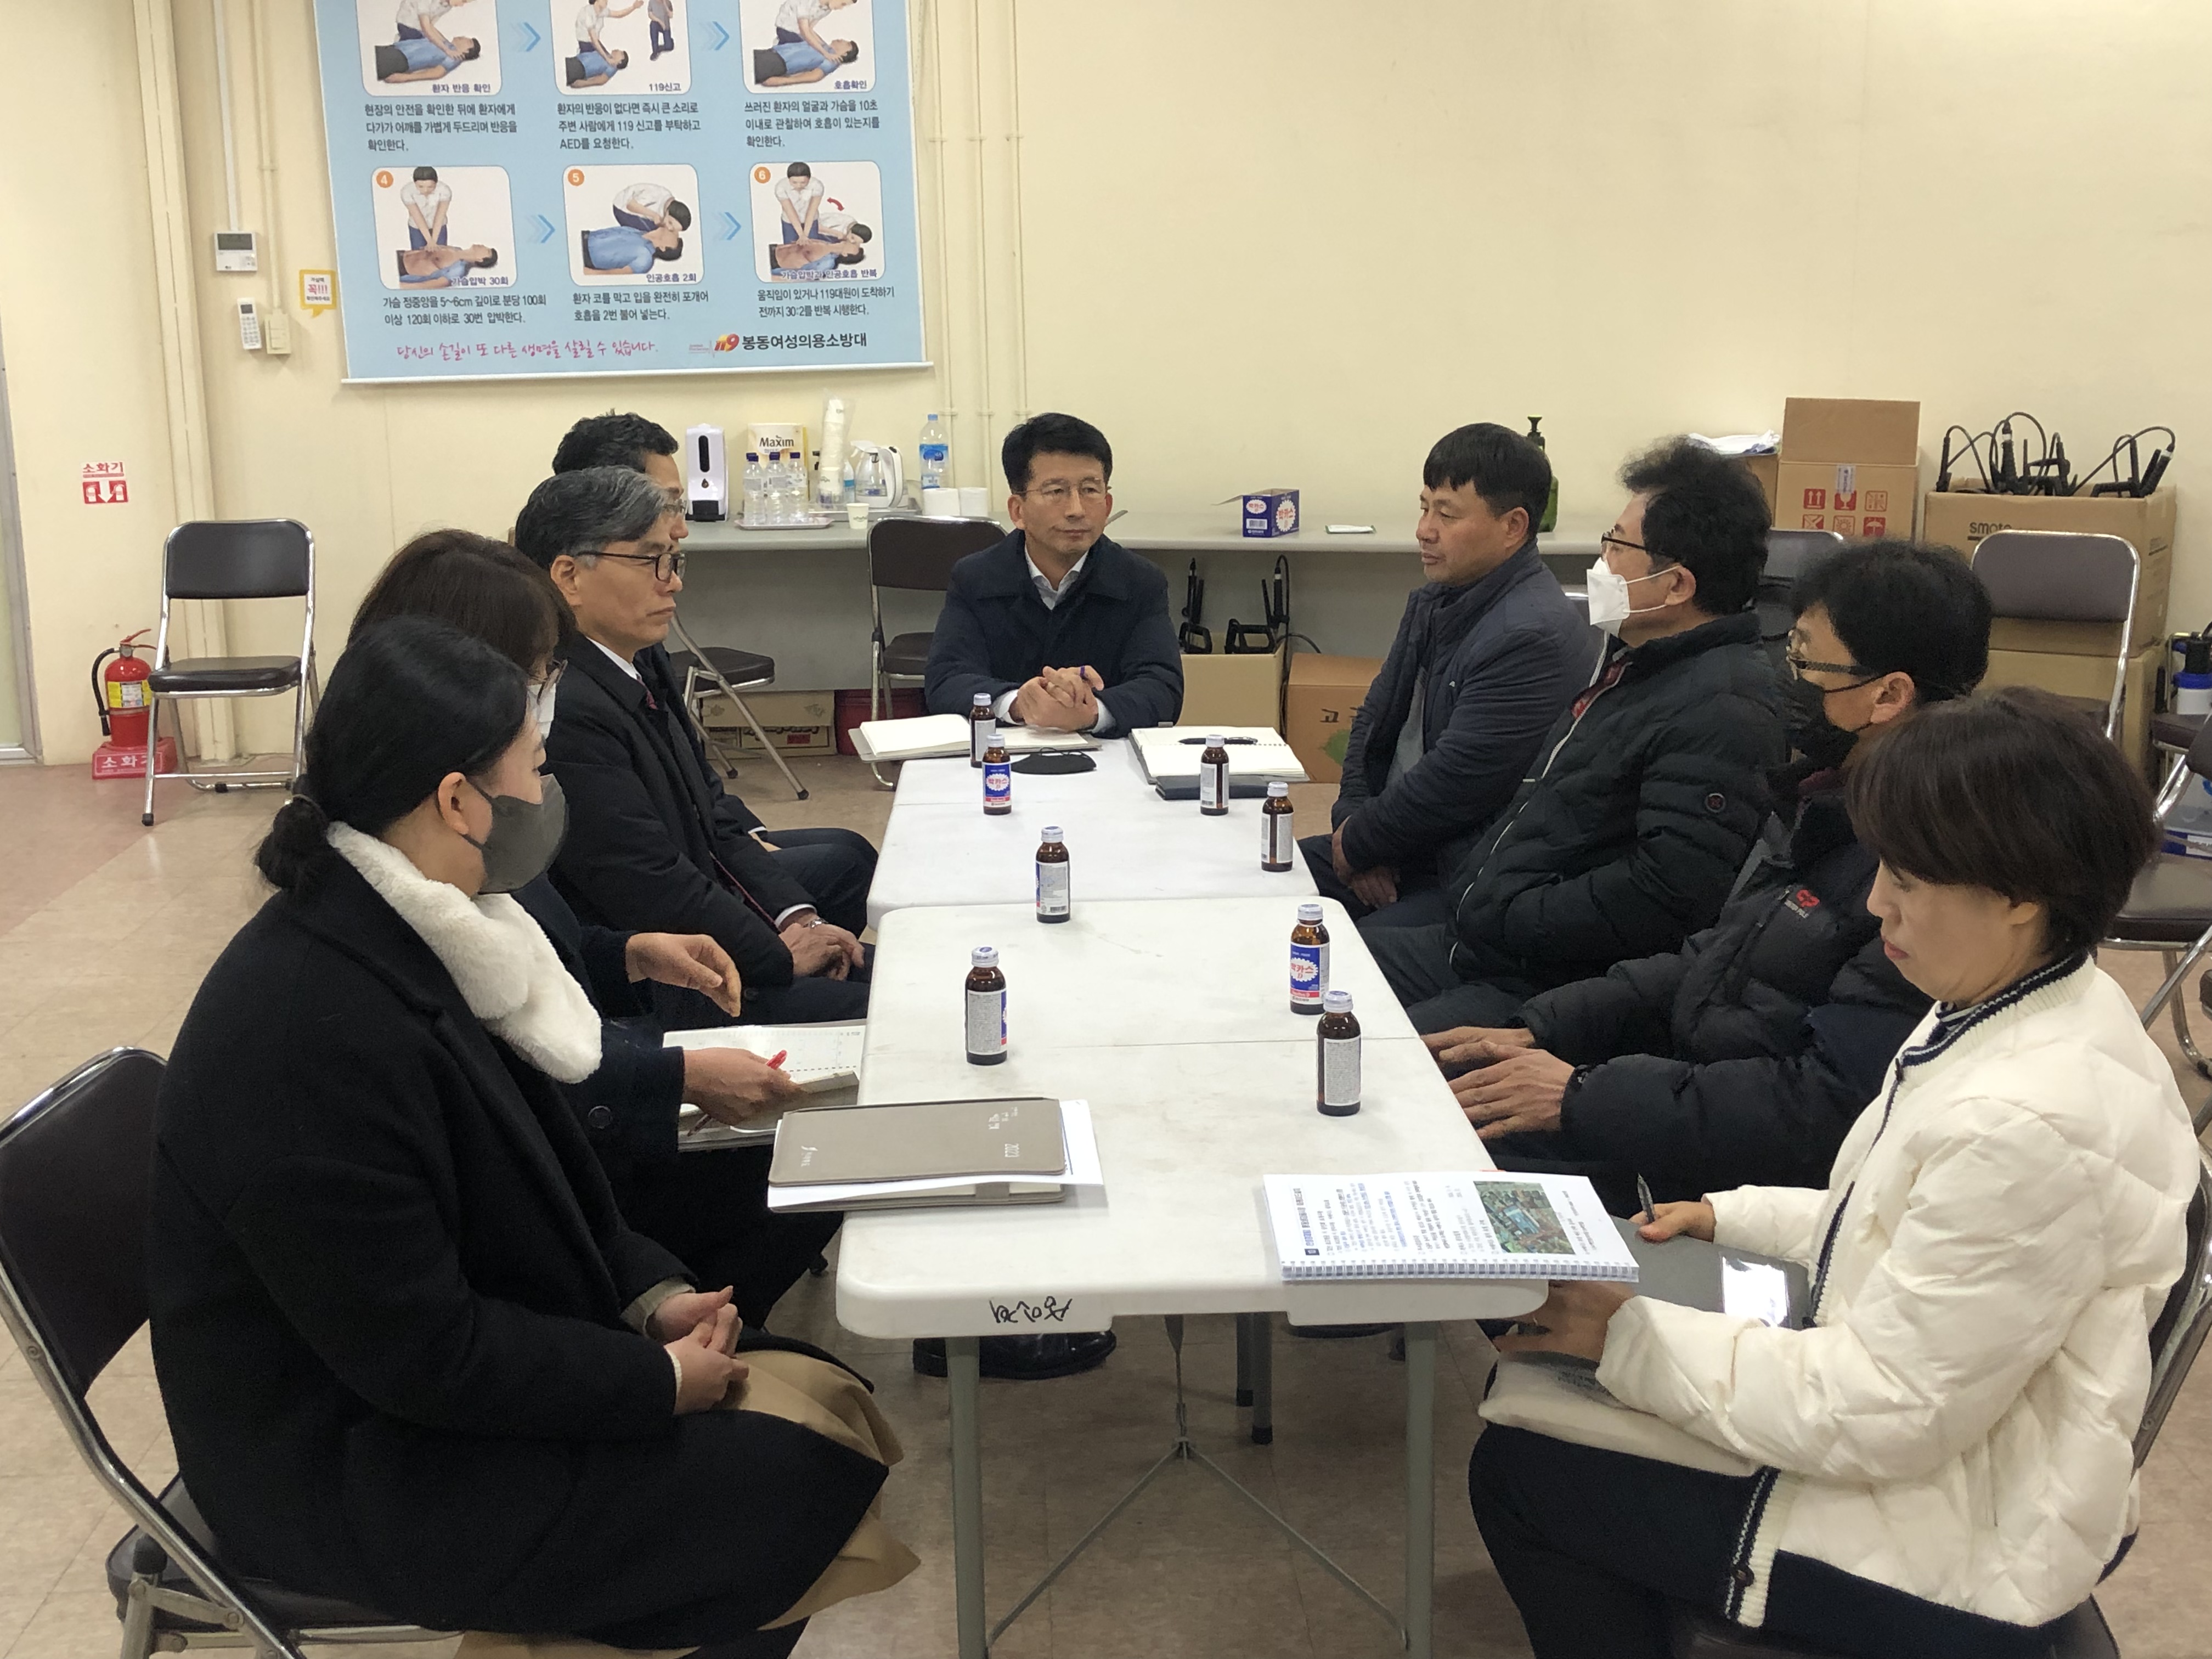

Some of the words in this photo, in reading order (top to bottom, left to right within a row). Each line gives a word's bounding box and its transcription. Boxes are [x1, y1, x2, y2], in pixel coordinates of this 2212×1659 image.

[432, 83, 449, 93] 환자
[453, 83, 470, 93] 반응
[473, 83, 490, 93] 확인
[649, 83, 681, 92] 119신고
[834, 81, 867, 89] 호흡확인
[365, 104, 393, 116] 현장의
[395, 104, 423, 116] 안전을
[426, 103, 454, 116] 확인한
[457, 103, 476, 116] 뒤에
[478, 103, 515, 115] 환자에게
[557, 103, 583, 115] 환자의
[585, 103, 612, 115] 반응이
[614, 103, 640, 115] 없다면
[642, 103, 659, 114] 즉시
[662, 103, 670, 114] 큰
[673, 102, 698, 113] 소리로
[744, 101, 770, 113] 쓰러진
[774, 101, 799, 112] 환자의
[802, 100, 828, 112] 얼굴과
[831, 100, 856, 112] 가슴을
[860, 99, 878, 110] 10초
[395, 121, 422, 133] 어깨를
[425, 121, 451, 133] 가볍게
[453, 121, 488, 133] 두드리며
[490, 121, 517, 133] 반응을
[558, 120, 576, 132] 주변
[579, 120, 614, 132] 사람에게
[618, 120, 634, 131] 119
[636, 120, 662, 132] 신고를
[665, 119, 701, 131] 부탁하고
[746, 119, 772, 131] 이내로
[775, 118, 811, 130] 관찰하여
[815, 117, 842, 129] 호흡이
[844, 117, 879, 128] 있는지를
[368, 139, 408, 151] 확인한다.
[560, 138, 590, 150] AED를
[593, 137, 634, 149] 요청한다.
[747, 136, 785, 148] 확인한다.
[380, 174, 388, 185] 4
[573, 173, 579, 183] 5
[759, 171, 766, 180] 6
[646, 274, 680, 283] 인공호흡
[682, 273, 697, 282] 2회
[826, 269, 857, 279] 인공호흡
[861, 268, 877, 278] 반복
[489, 276, 509, 285] 30회
[573, 292, 591, 304] 환자
[593, 292, 611, 304] 코를
[613, 292, 630, 304] 막고
[634, 291, 651, 303] 입을
[654, 291, 680, 303] 완전히
[682, 290, 709, 302] 포개어
[758, 289, 791, 301] 움직임이
[793, 288, 818, 300] 있거나
[820, 287, 860, 300] 119대원이
[861, 286, 894, 298] 도착하기
[383, 296, 400, 308] 가슴
[403, 296, 438, 308] 정중앙을
[440, 296, 472, 308] 5~6cm
[475, 295, 501, 307] 깊이로
[503, 295, 521, 307] 분당
[523, 294, 546, 306] 100회
[574, 309, 600, 321] 호흡을
[603, 309, 617, 320] 2번
[619, 309, 637, 320] 불어
[640, 308, 670, 320] 넣는다.
[759, 306, 784, 318] 전까지
[786, 305, 812, 317] 30:2를
[814, 304, 831, 316] 반복
[833, 303, 869, 315] 시행한다.
[385, 313, 402, 325] 이상
[407, 313, 431, 325] 120회
[433, 313, 460, 325] 이하로
[464, 312, 483, 324] 30번
[487, 312, 526, 324] 압박한다.
[742, 332, 867, 351] 봉동여성의용소방대
[397, 346, 433, 359] 당신의
[439, 342, 471, 361] 손길이
[476, 343, 488, 356] 또
[494, 342, 517, 358] 다른
[522, 340, 561, 359] 생명을
[565, 340, 594, 359] 살릴
[597, 341, 607, 356] 수
[612, 340, 658, 357] 있습니다.
[759, 436, 794, 447] Maxim
[83, 462, 123, 473] 소화기
